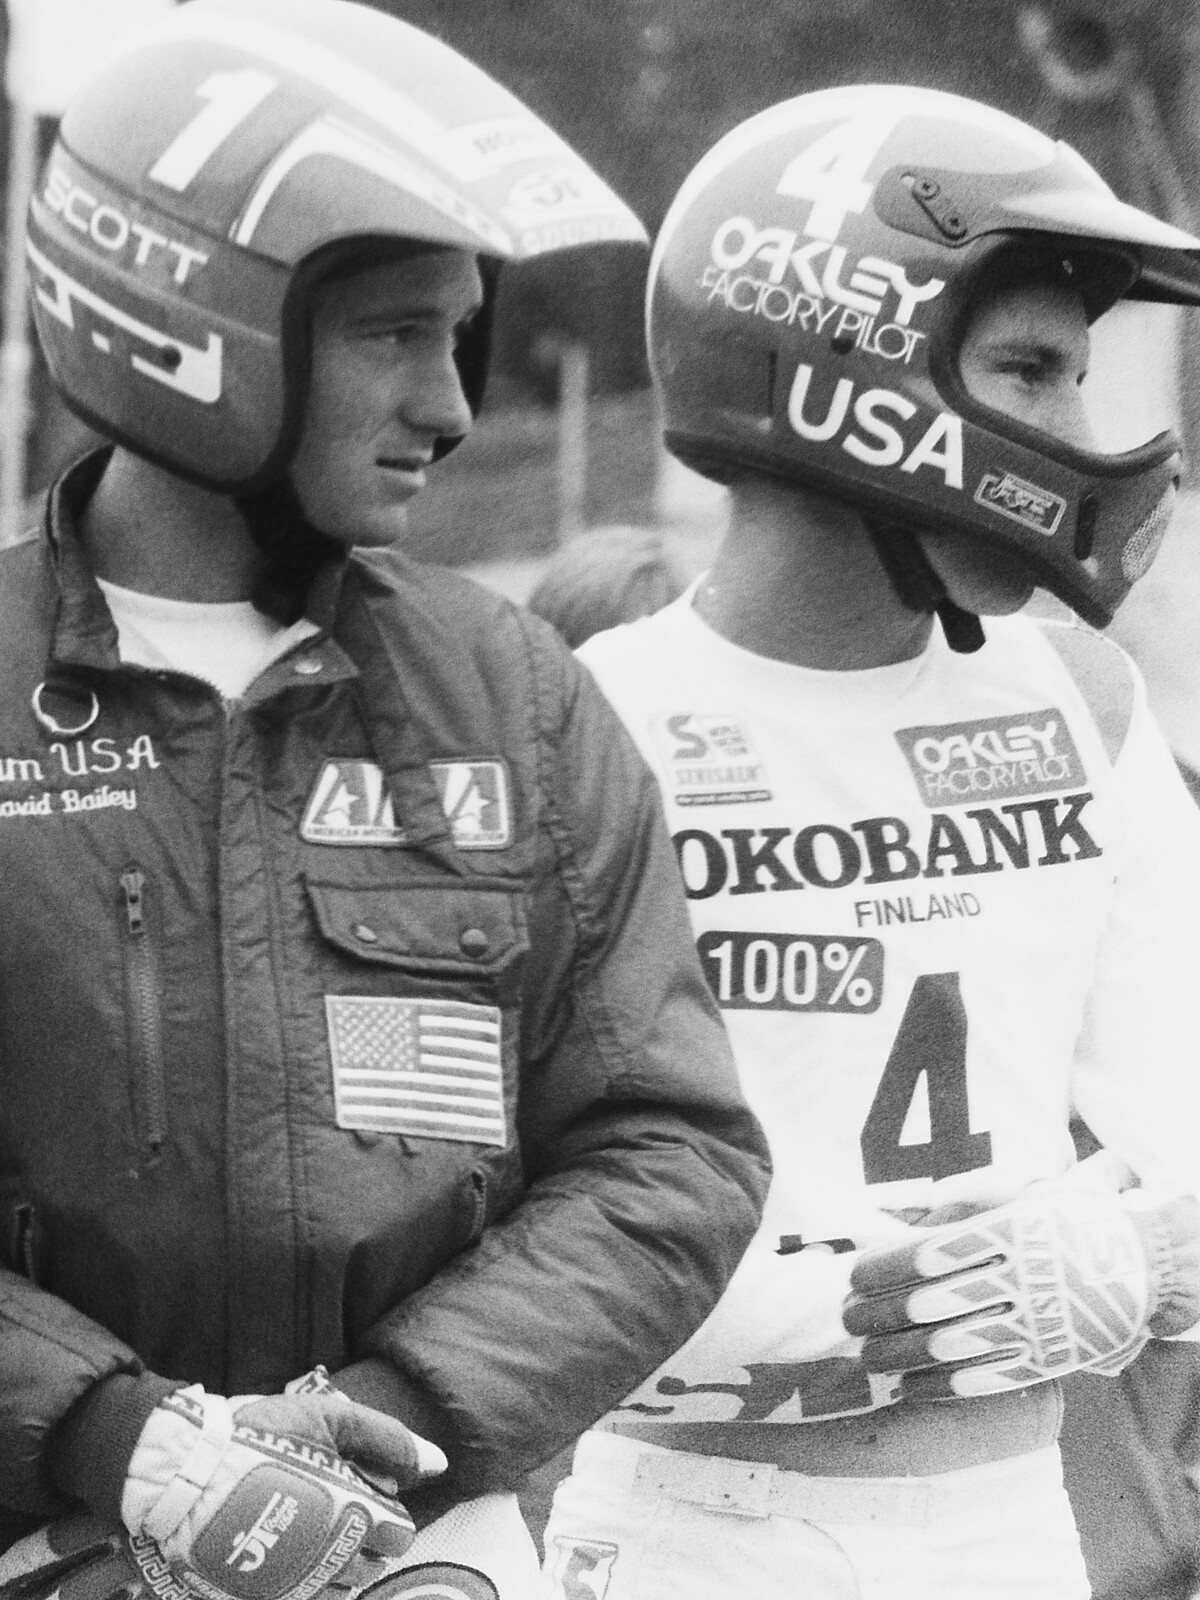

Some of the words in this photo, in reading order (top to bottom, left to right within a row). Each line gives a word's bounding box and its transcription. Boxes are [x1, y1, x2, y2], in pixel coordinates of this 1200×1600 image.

[150, 68, 280, 191] 1
[776, 112, 904, 244] 4
[44, 166, 208, 285] SCOTT
[711, 215, 945, 325] OAKLEY
[700, 266, 840, 341] FACTORY
[834, 310, 926, 364] PILOT
[787, 364, 964, 489] USA
[49, 734, 161, 777] USA
[60, 785, 138, 811] Bailey
[913, 720, 1057, 773] OAKLEY
[922, 762, 1018, 798] FACTORY
[1019, 753, 1072, 785] PILOT
[672, 792, 1103, 901] OKOBANK
[854, 891, 983, 929] FINLAND
[708, 939, 874, 1008] 100%
[860, 971, 993, 1185] 4
